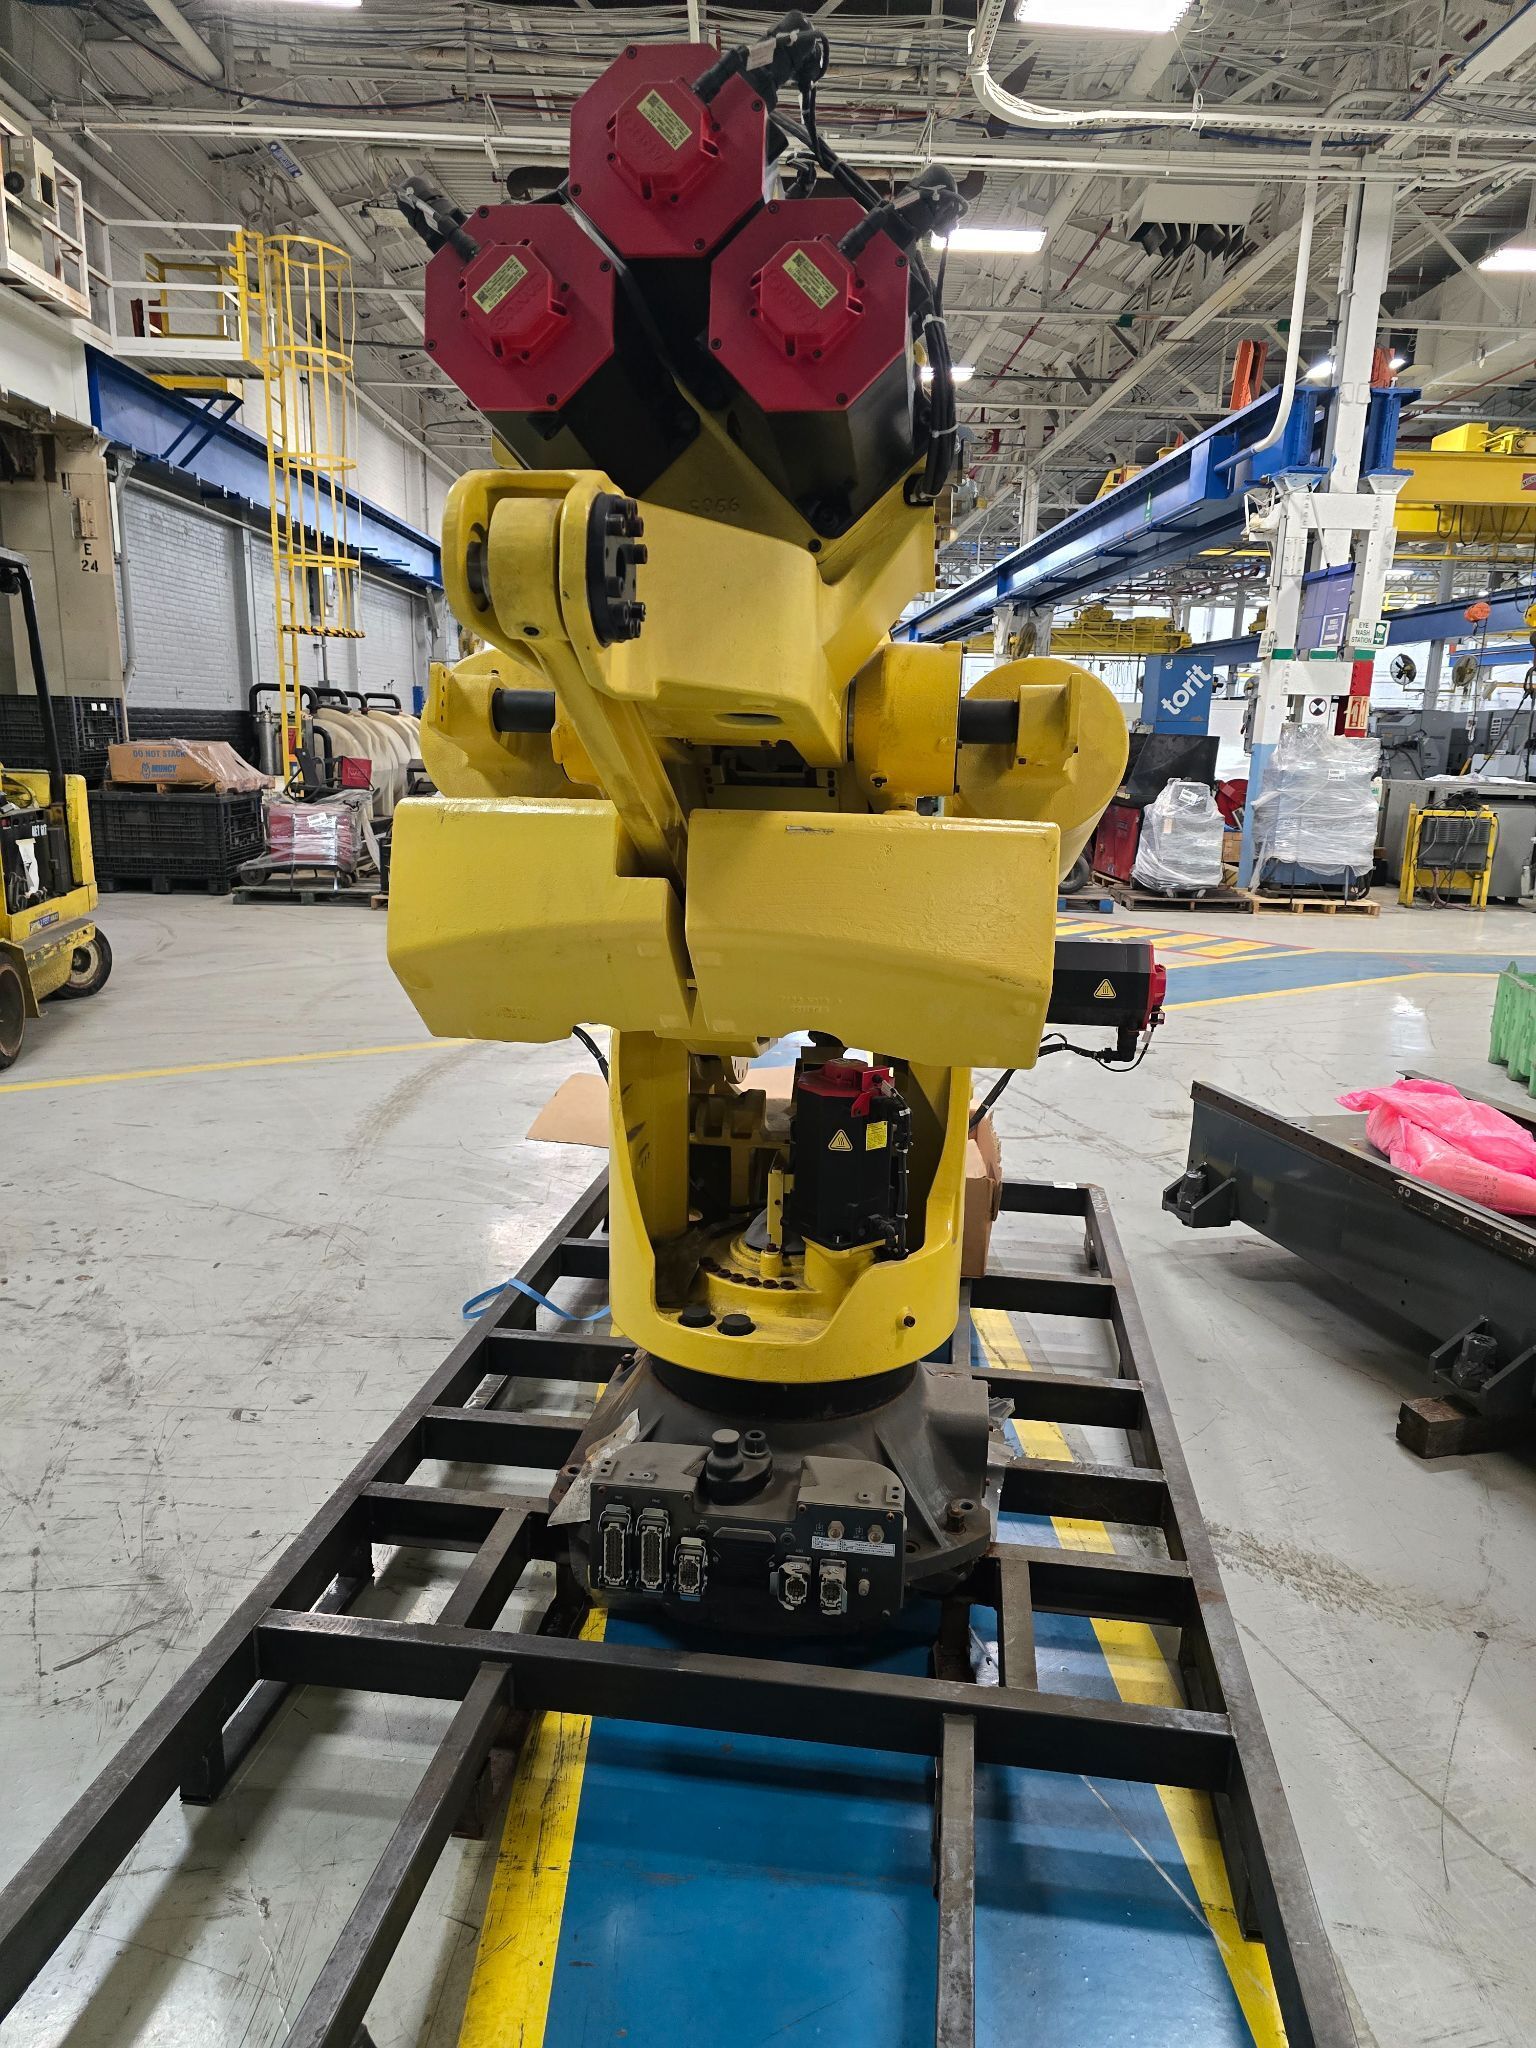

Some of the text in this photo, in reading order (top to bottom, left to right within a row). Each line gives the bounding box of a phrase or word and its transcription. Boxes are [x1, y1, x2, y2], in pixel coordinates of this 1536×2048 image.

[83, 543, 92, 556] E
[81, 559, 99, 573] 24
[1358, 621, 1370, 629] EYE
[1355, 629, 1371, 637] WASH
[1351, 636, 1373, 644] STATION
[1161, 664, 1212, 715] torit
[133, 749, 144, 758] DO
[145, 749, 160, 758] NOT
